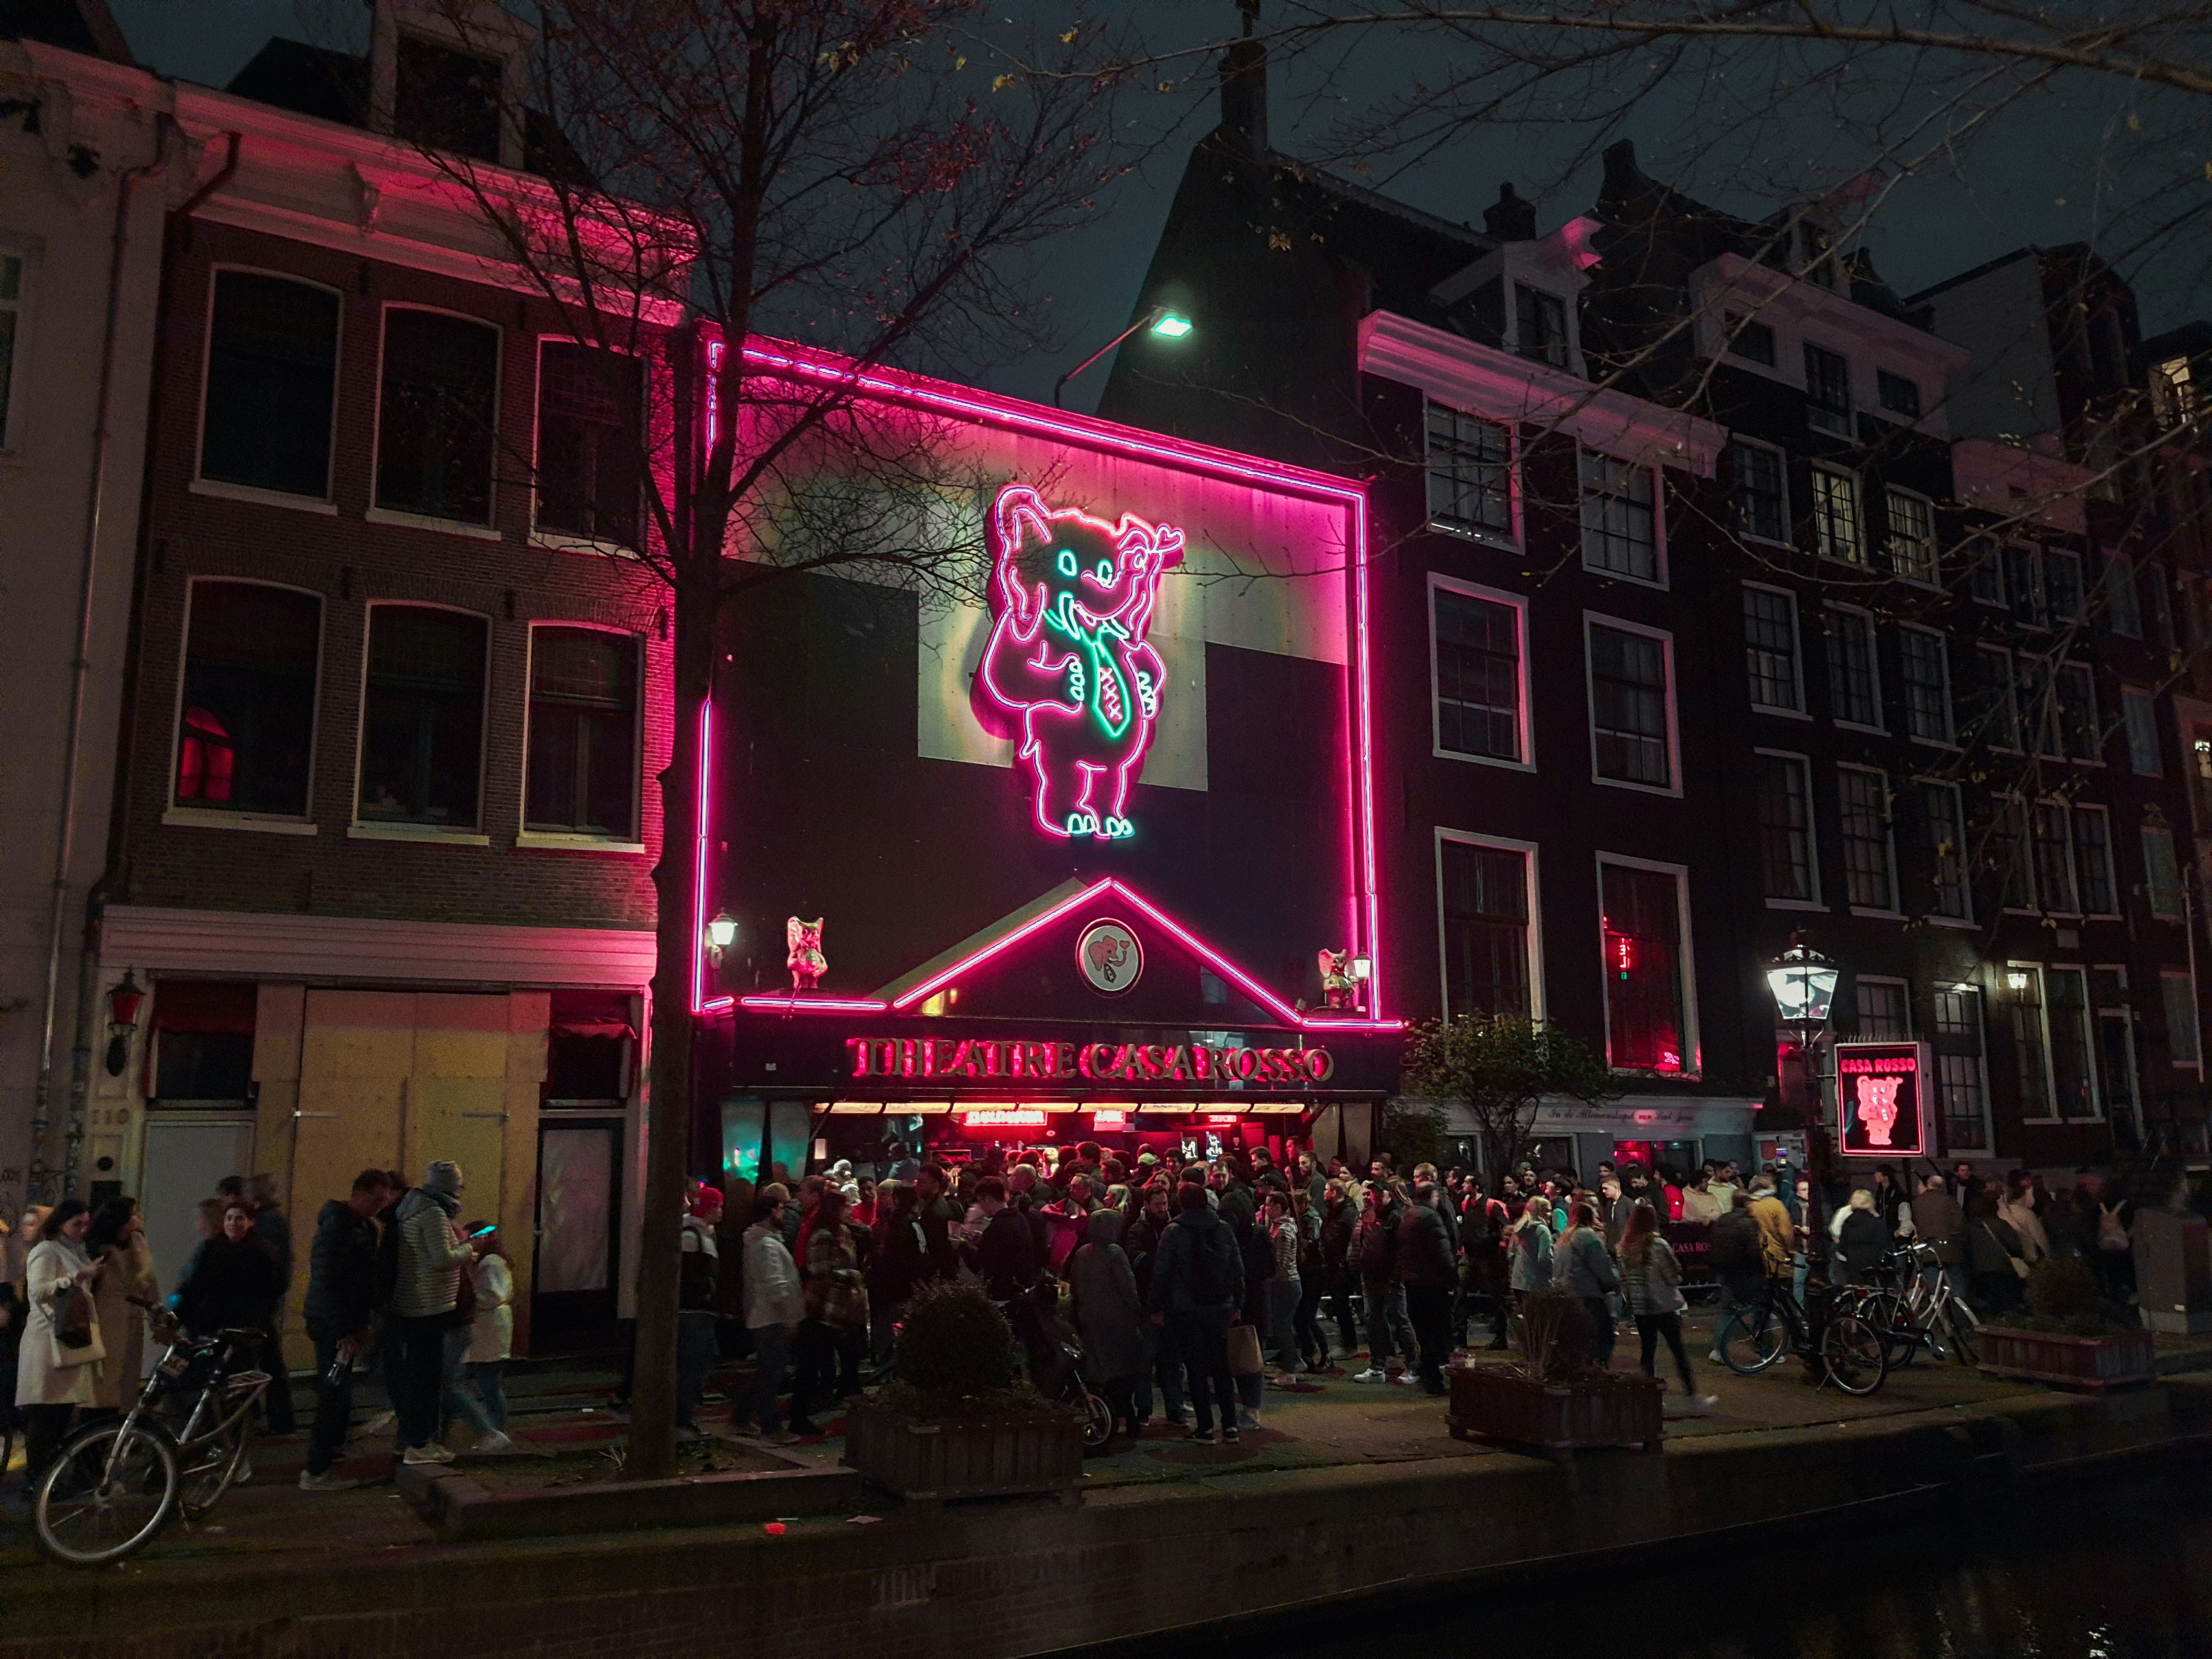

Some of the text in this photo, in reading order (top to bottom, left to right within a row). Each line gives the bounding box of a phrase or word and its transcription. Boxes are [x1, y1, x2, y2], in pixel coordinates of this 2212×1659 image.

[847, 1039, 1334, 1082] THEATRE CASA ROSSO
[1841, 1058, 1916, 1073] CASA ROSSO
[1672, 1243, 1694, 1253] CASA
